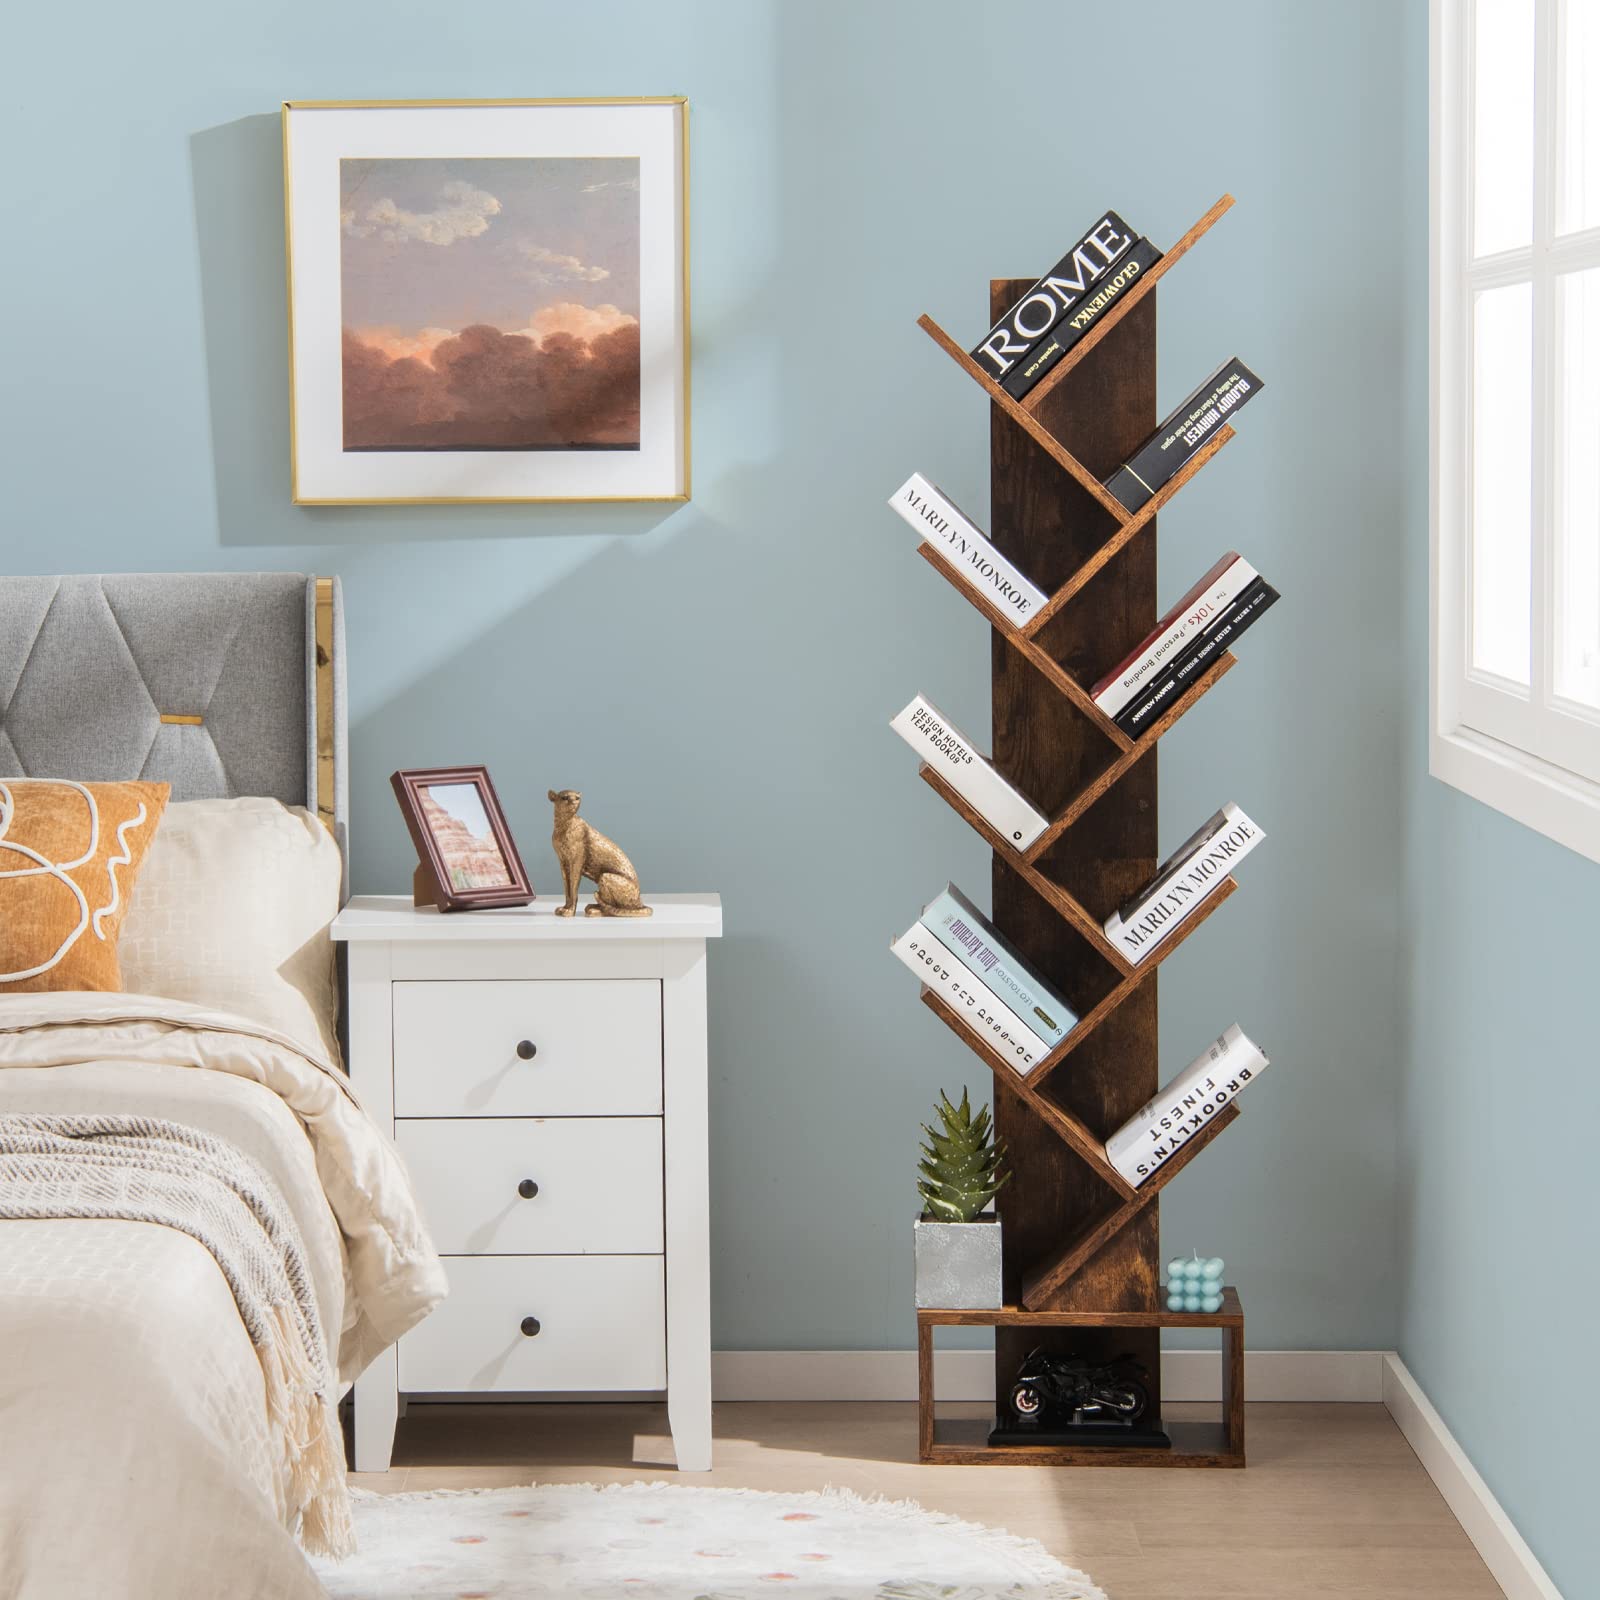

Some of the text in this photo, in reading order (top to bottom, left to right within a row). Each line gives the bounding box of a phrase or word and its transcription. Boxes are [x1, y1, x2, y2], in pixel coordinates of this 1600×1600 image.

[978, 219, 1132, 374] ROME
[1228, 373, 1240, 383] The
[1183, 379, 1250, 447] BLOODY HARVEST
[1184, 418, 1193, 428] for
[904, 490, 1031, 613] MARILYN MONROE
[1216, 591, 1226, 600] The
[1156, 629, 1185, 661] Personal
[1123, 659, 1155, 688] Branding
[910, 714, 930, 736] YEAR
[916, 708, 973, 764] DESIGN HOTELS
[1124, 821, 1255, 950] MARILYN MONROE
[950, 919, 1000, 972] Anna Karenina
[994, 966, 1033, 1007] LEO TOLSTOY
[951, 983, 975, 1007] and
[977, 1008, 1033, 1063] passion
[1137, 1068, 1252, 1176] BROOKLYN'S
[1150, 1078, 1215, 1142] FINEST
